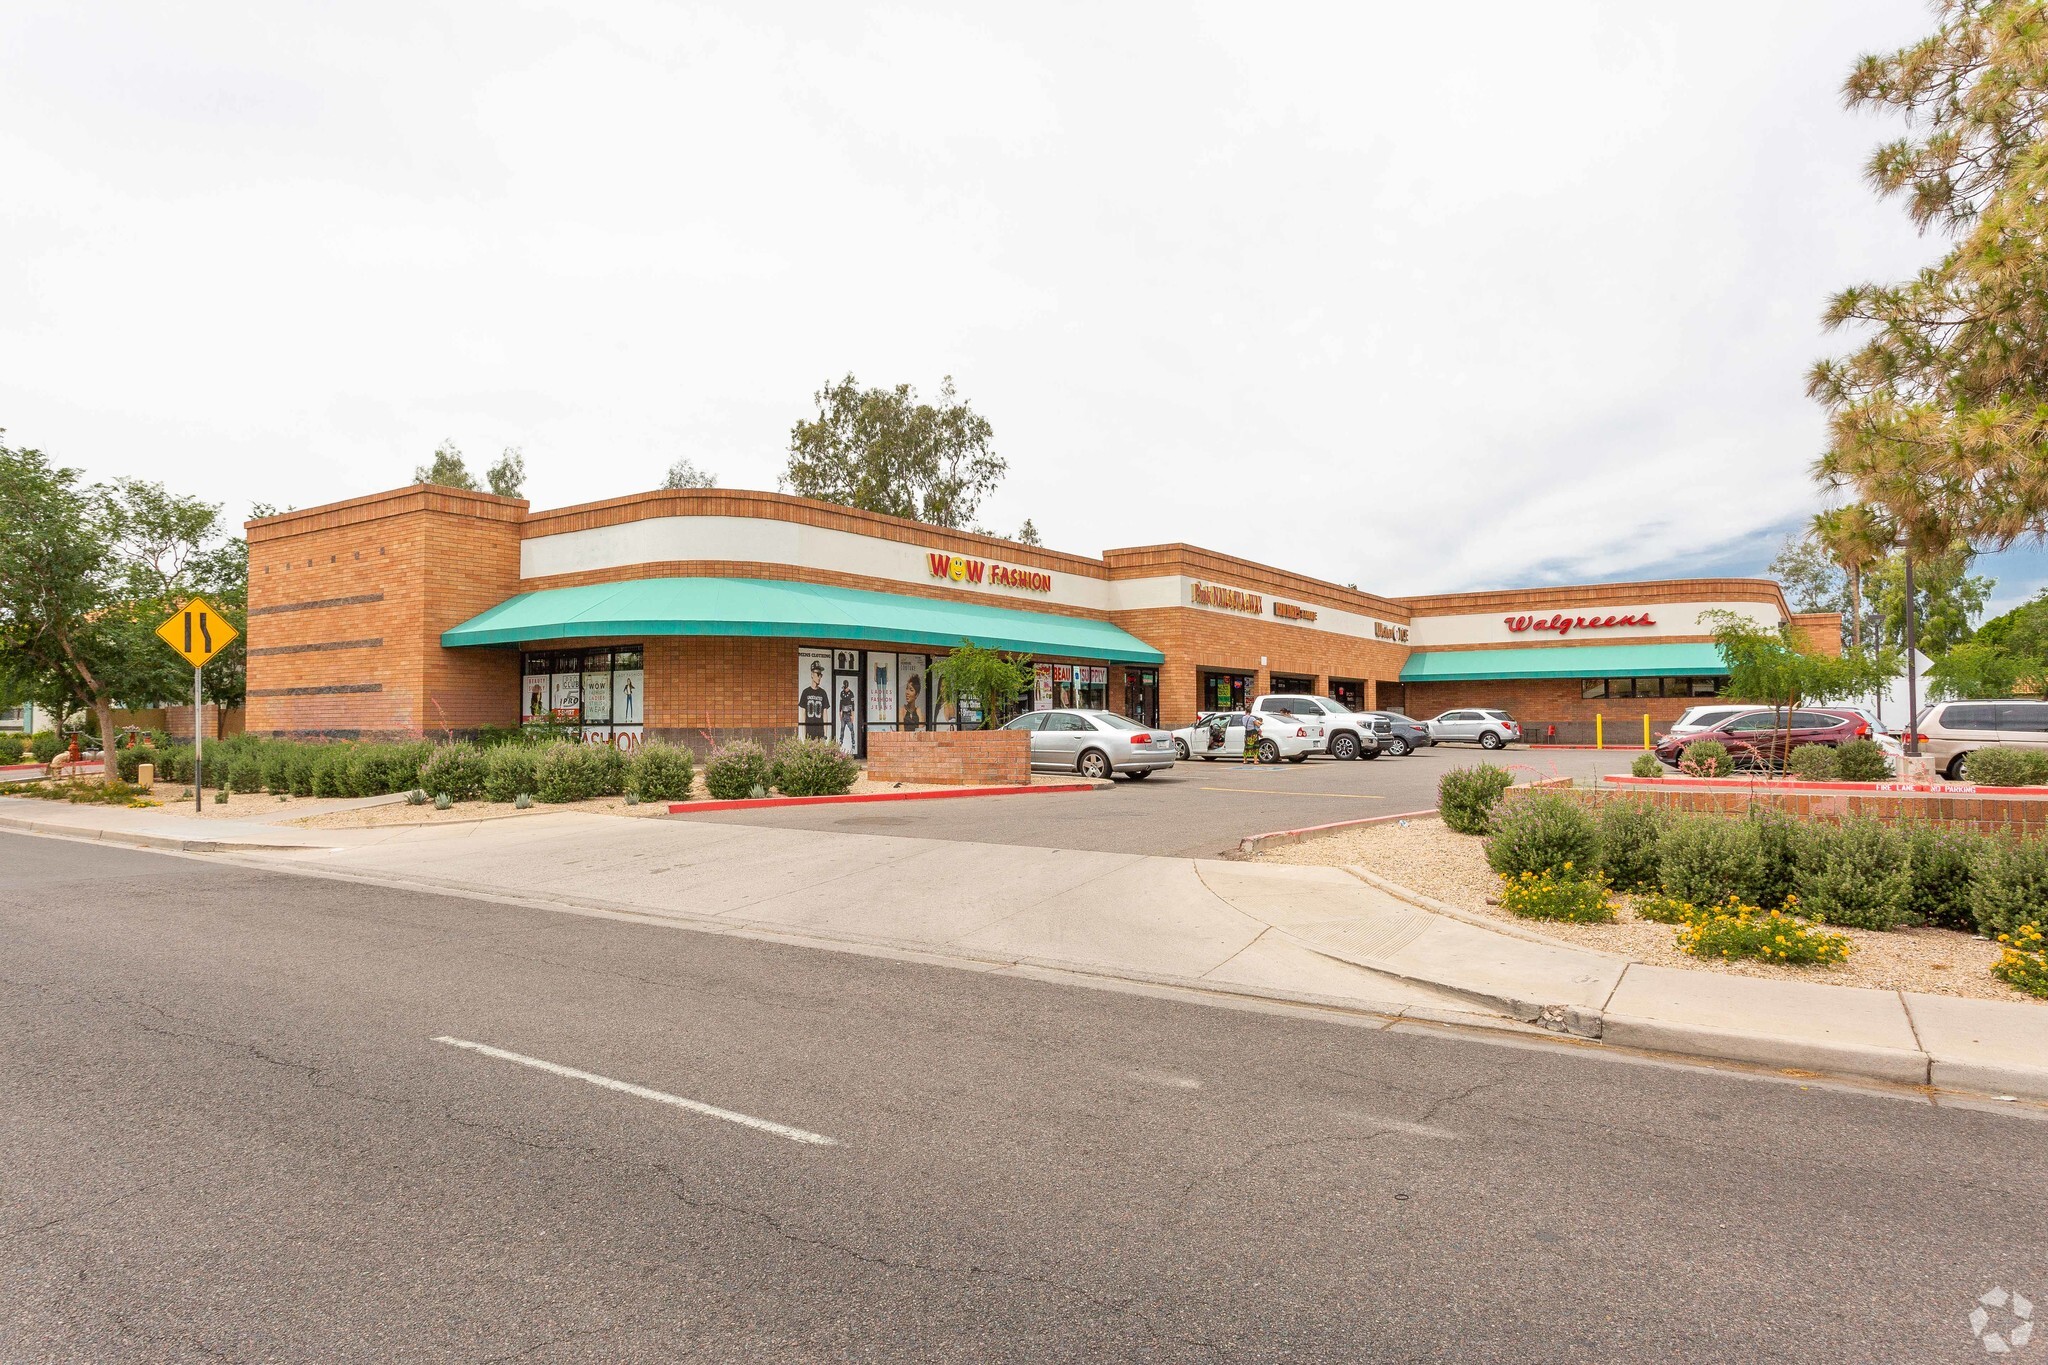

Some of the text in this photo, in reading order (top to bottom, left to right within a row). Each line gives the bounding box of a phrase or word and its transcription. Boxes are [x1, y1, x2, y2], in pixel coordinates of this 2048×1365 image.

[926, 553, 1051, 592] WOW FASHION
[1504, 612, 1657, 635] Walgreens
[589, 682, 606, 690] WOW
[1930, 785, 1941, 793] NO
